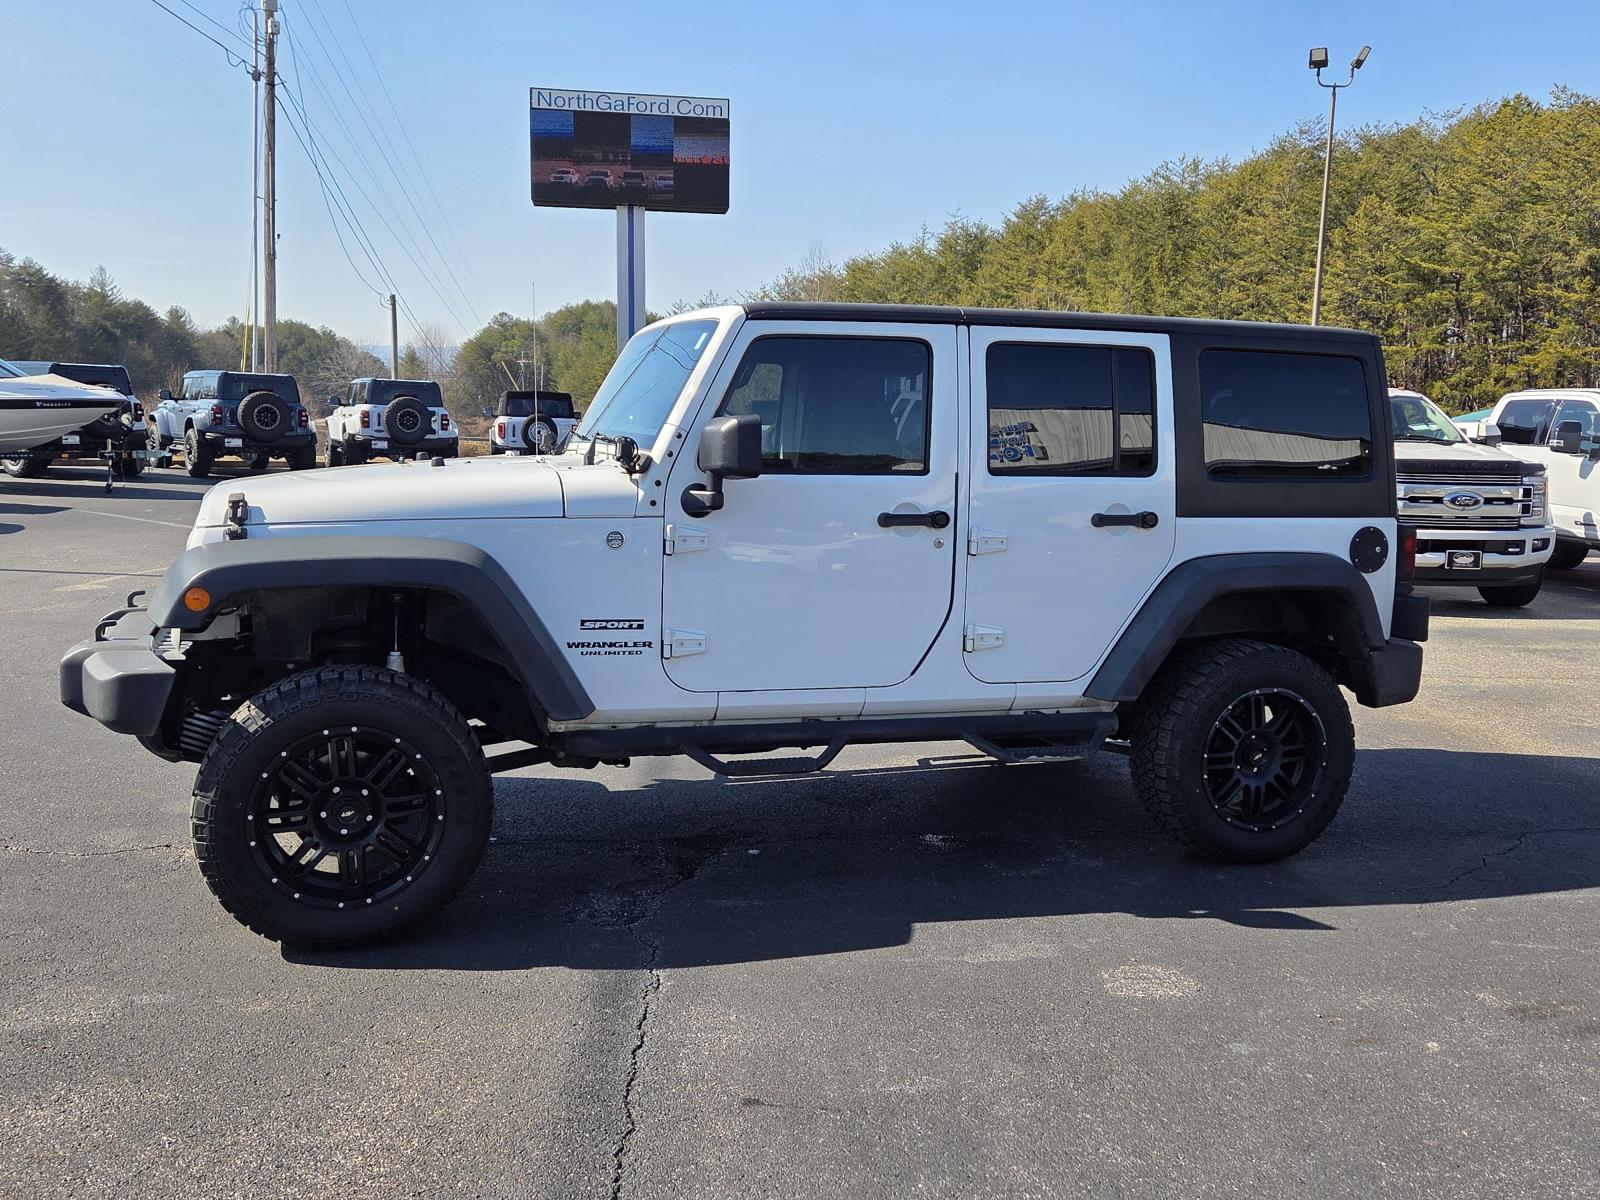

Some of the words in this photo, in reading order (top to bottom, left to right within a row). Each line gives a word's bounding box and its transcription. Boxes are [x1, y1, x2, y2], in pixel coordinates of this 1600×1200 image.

[537, 91, 723, 117] NorthGaFord.Com
[1454, 496, 1476, 505] Ford
[580, 620, 644, 629] SPORT
[566, 641, 654, 649] WRANGLER
